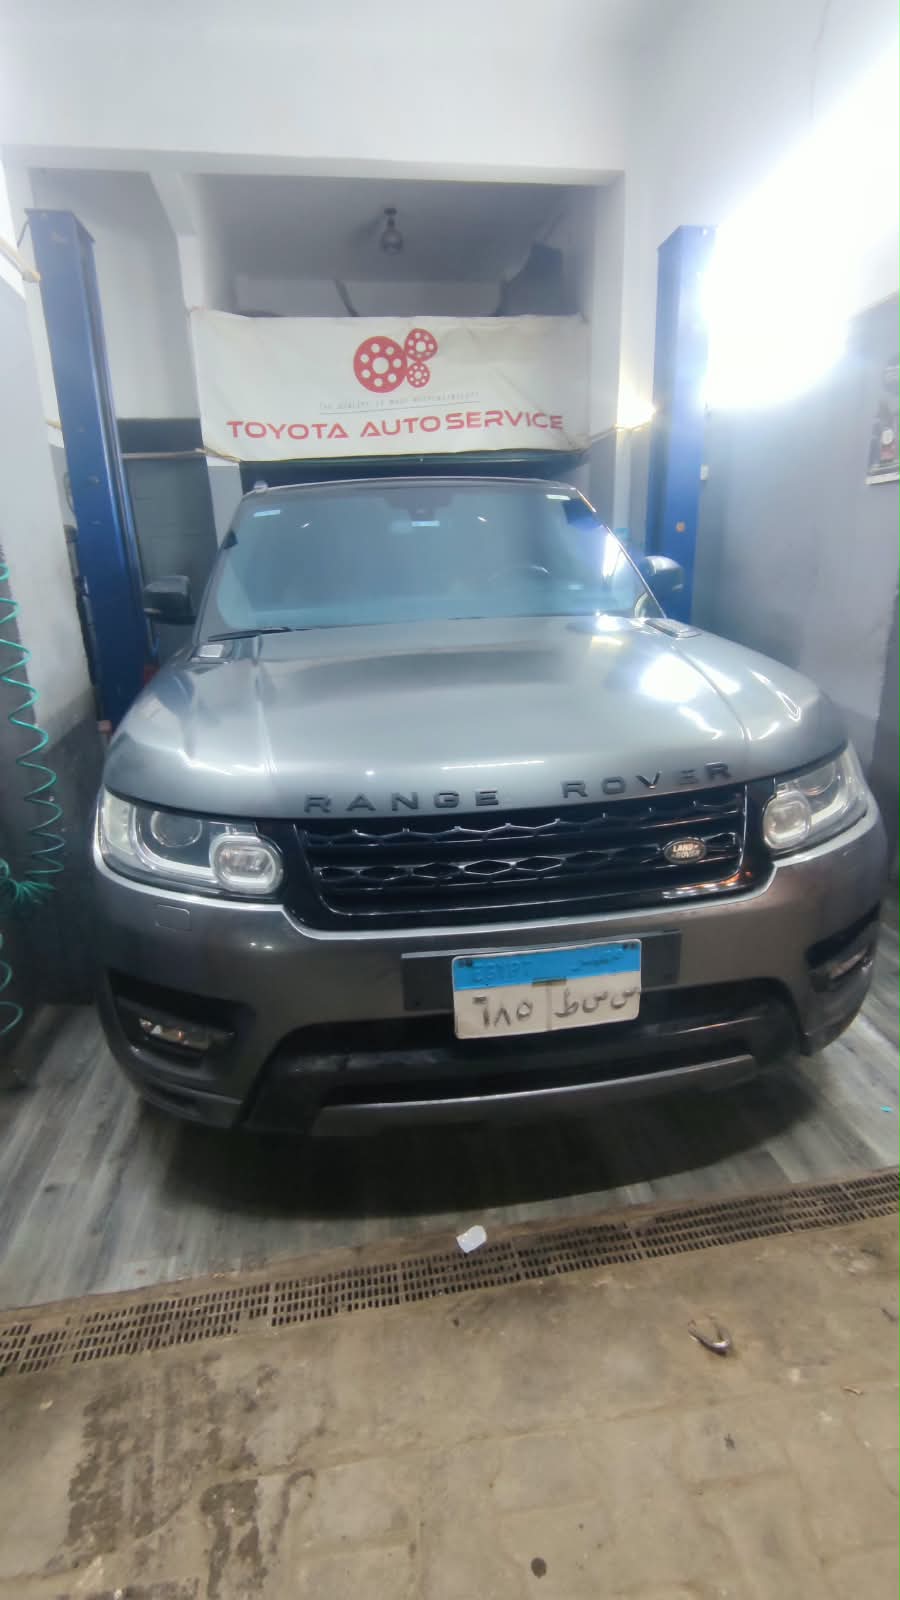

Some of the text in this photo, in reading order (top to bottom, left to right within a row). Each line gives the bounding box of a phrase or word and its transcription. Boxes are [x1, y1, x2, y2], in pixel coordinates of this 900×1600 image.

[226, 420, 350, 440] TOYOTA
[303, 761, 732, 814] RANGE ROVER
